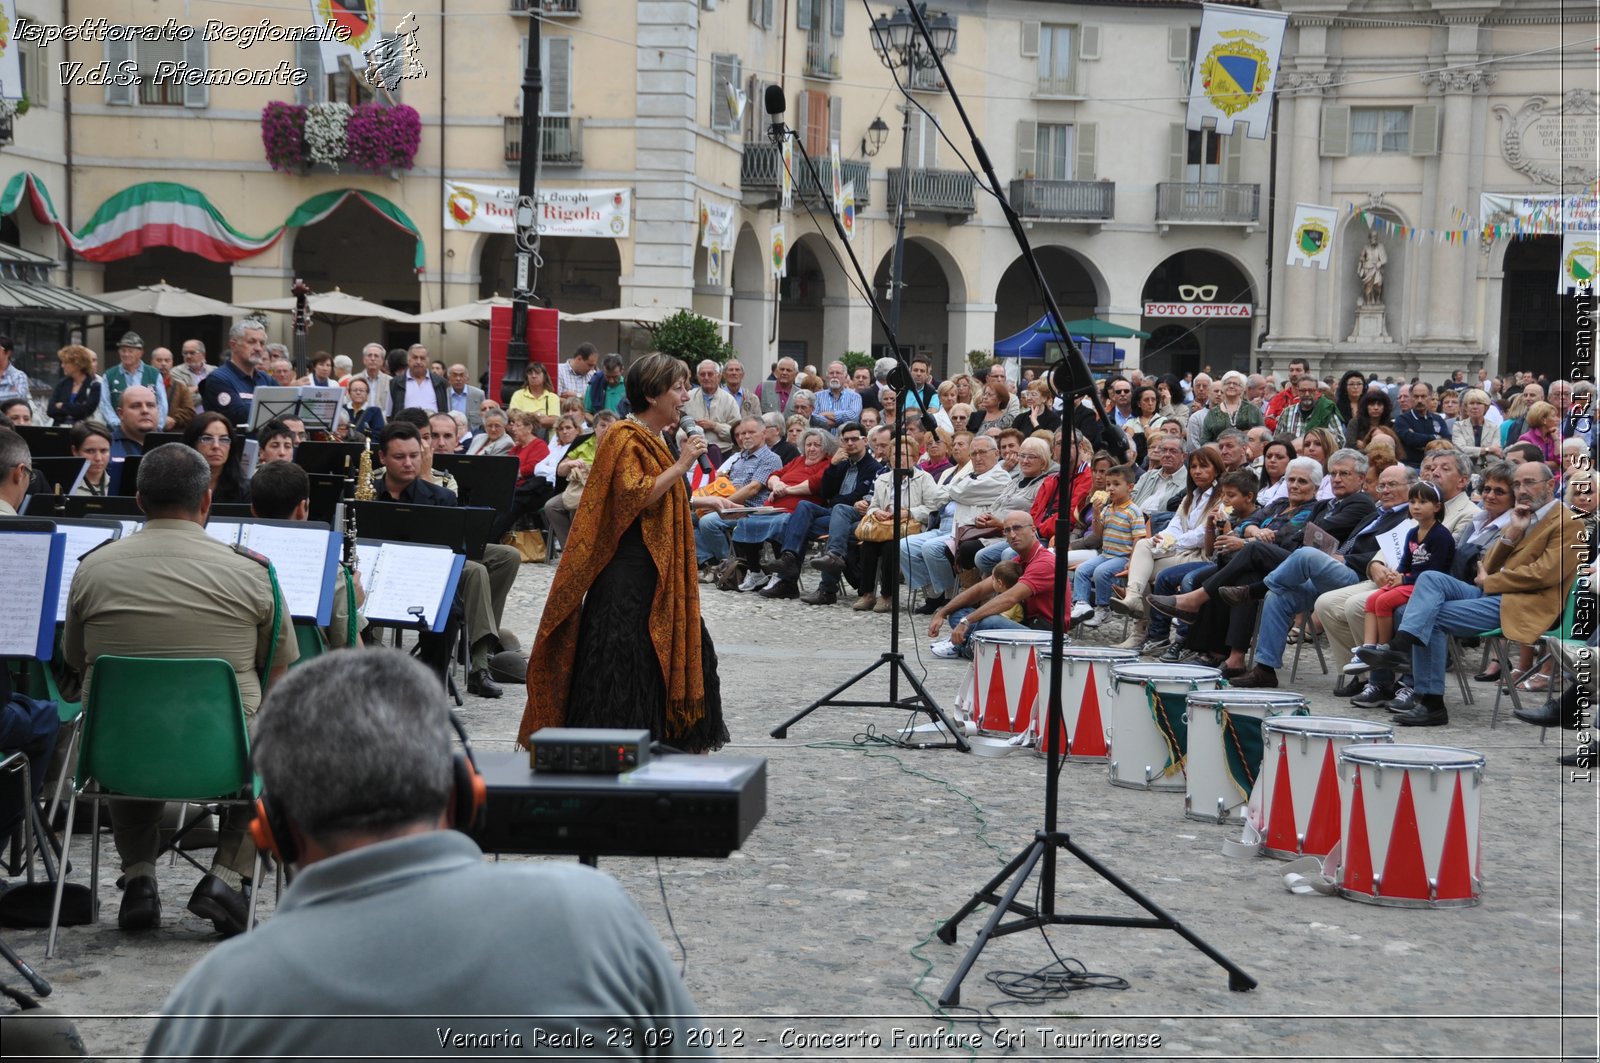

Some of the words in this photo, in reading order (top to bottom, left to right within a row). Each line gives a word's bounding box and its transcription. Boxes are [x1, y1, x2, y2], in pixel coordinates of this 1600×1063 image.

[550, 192, 589, 205] Borghi
[543, 204, 601, 223] Rigola
[1146, 304, 1187, 315] FOTO
[1192, 305, 1250, 316] OTTICA
